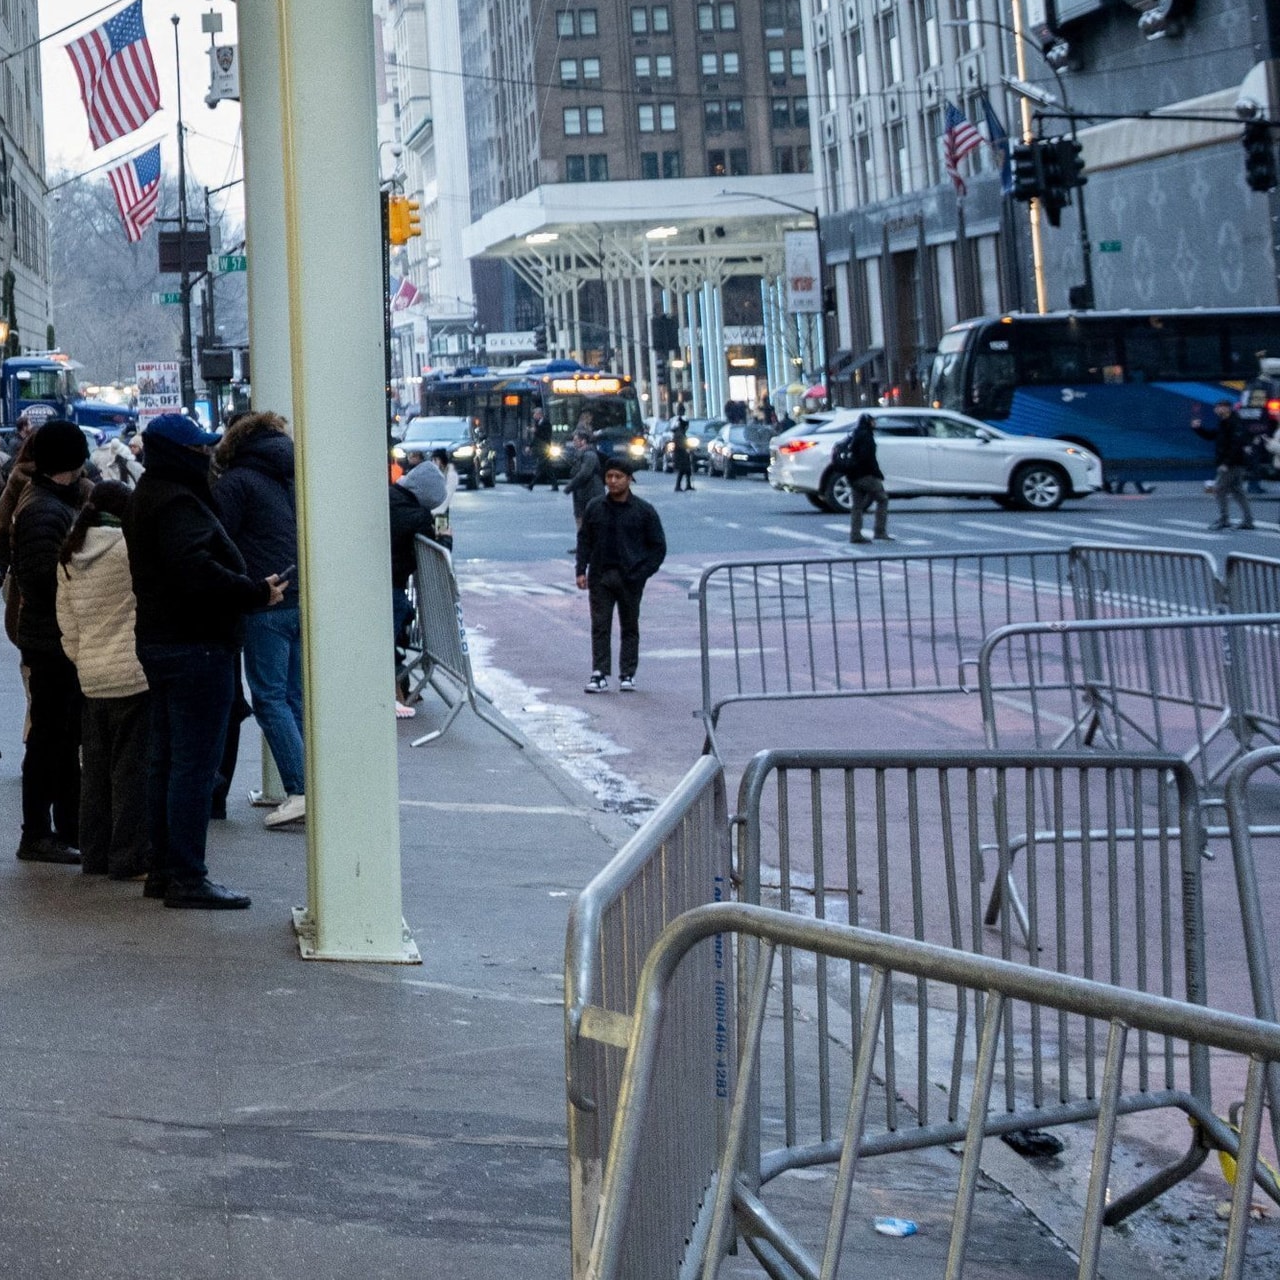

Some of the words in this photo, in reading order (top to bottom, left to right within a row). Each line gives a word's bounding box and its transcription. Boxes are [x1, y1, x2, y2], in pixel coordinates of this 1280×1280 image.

[490, 337, 533, 347] DELVA
[160, 395, 179, 405] OFF
[455, 603, 469, 653] NYPD
